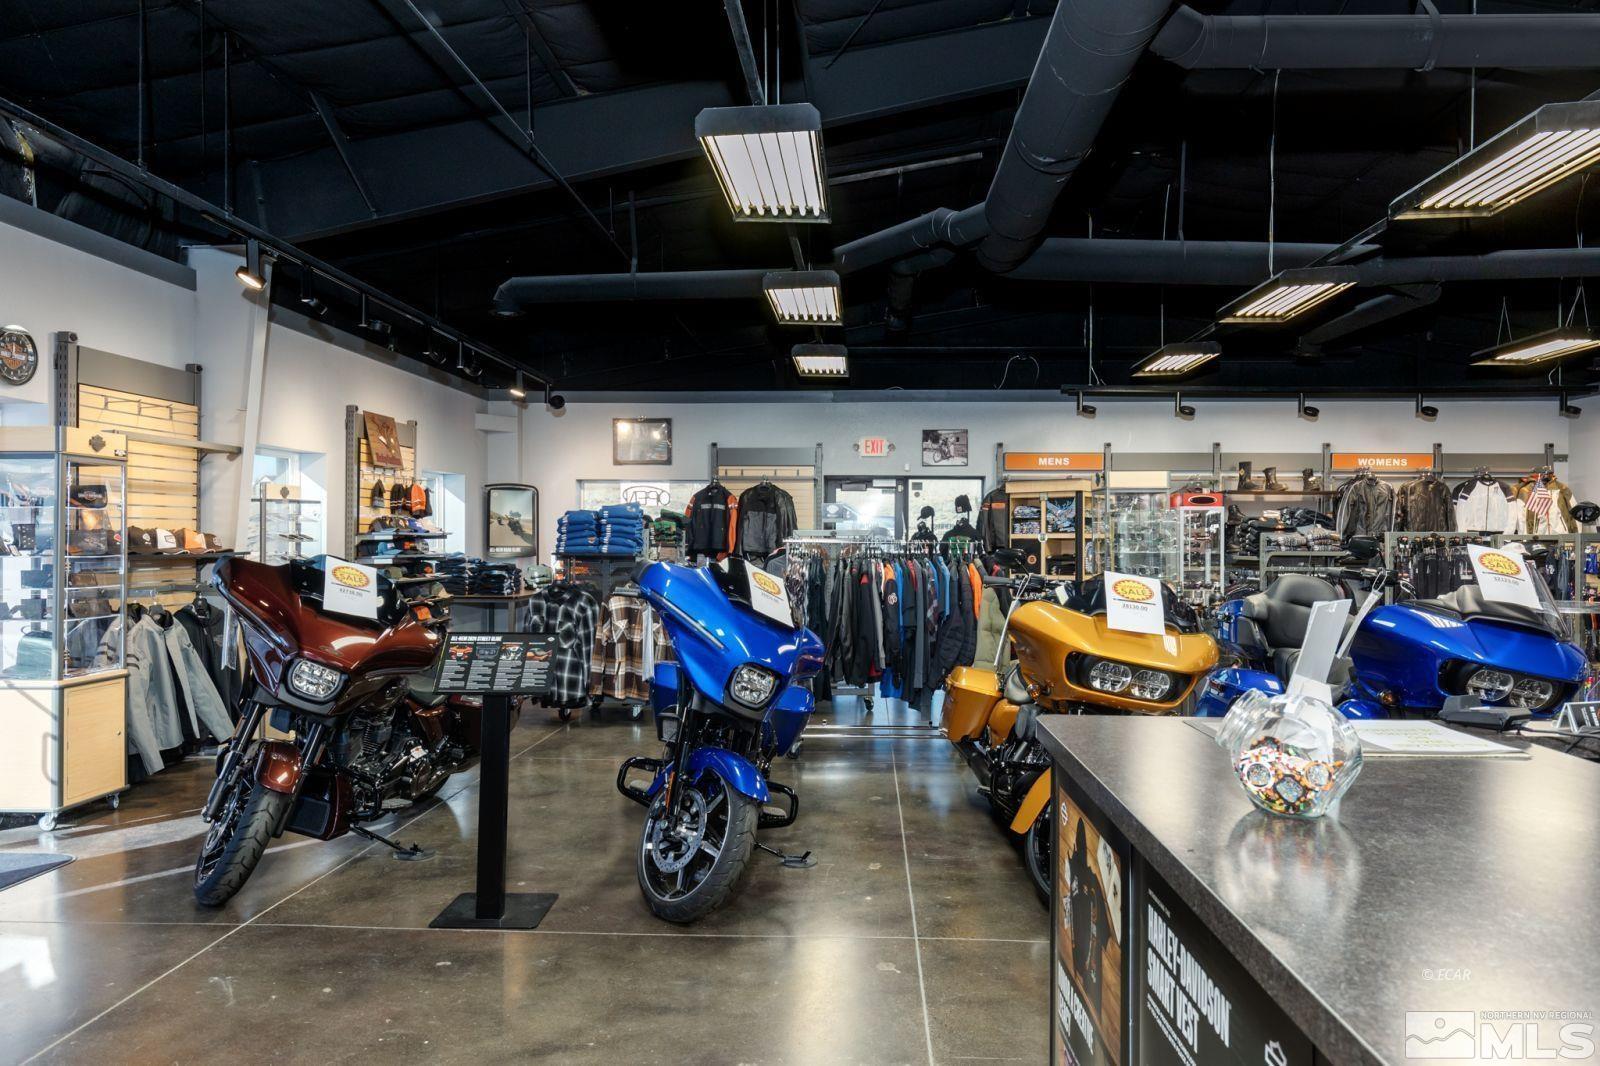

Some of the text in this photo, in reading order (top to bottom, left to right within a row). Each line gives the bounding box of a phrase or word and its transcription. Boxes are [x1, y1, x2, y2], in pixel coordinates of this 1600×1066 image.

[864, 439, 884, 454] EXIT
[1038, 457, 1070, 466] MENS
[1357, 458, 1408, 467] WOMENS
[1121, 587, 1148, 597] SALE
[1148, 903, 1231, 1048] HARLEY-DAVIDSON
[1147, 947, 1176, 1019] SMART
[1176, 984, 1199, 1054] VEST
